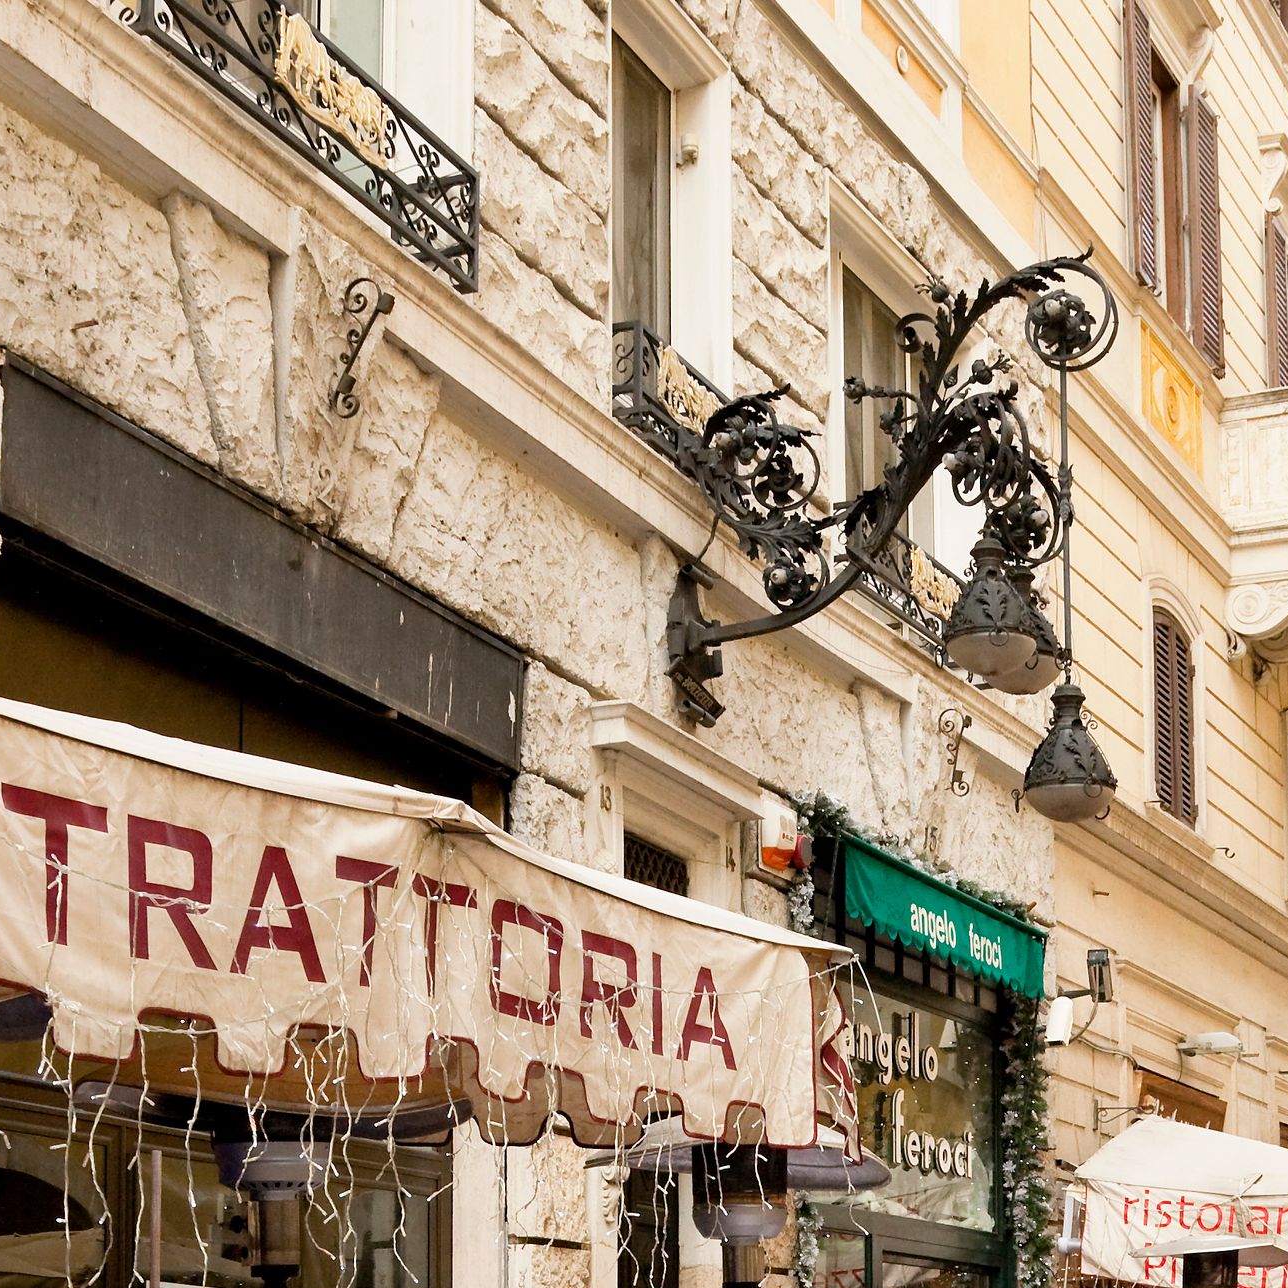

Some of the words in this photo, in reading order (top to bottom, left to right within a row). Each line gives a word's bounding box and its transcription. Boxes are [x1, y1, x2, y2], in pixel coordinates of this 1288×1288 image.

[599, 784, 613, 812] 13
[725, 840, 737, 872] 14
[922, 824, 939, 852] 15
[0, 781, 738, 1071] TRATTORIA
[910, 903, 957, 949] angelo
[968, 923, 1003, 970] feroci
[843, 1011, 939, 1086] angelo
[891, 1088, 974, 1179] feroci
